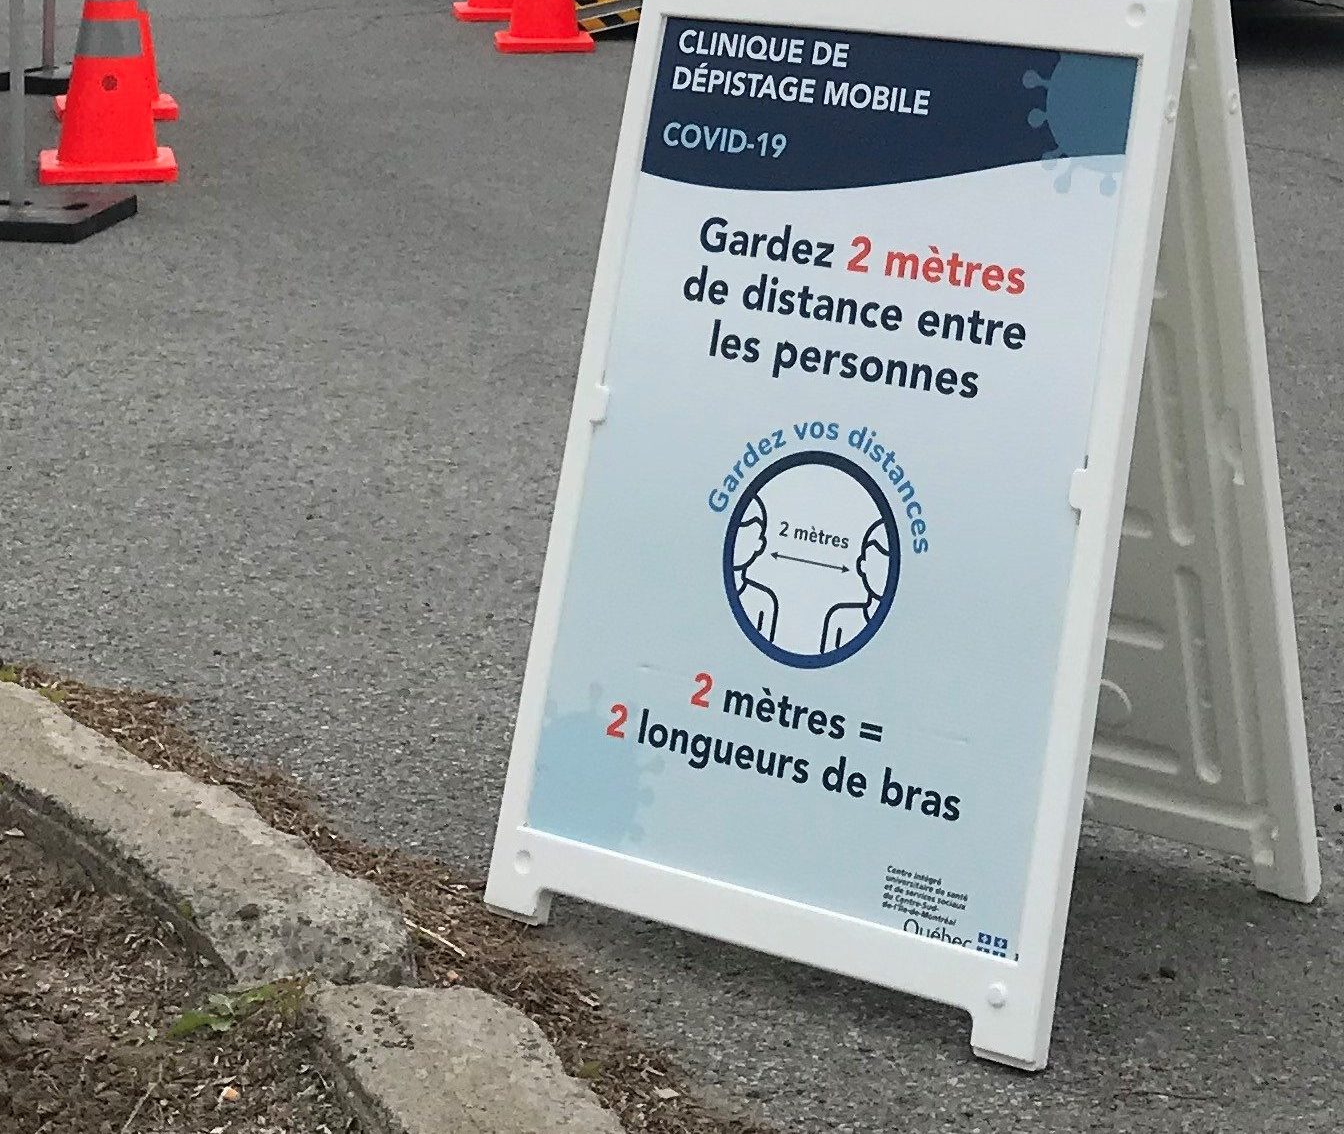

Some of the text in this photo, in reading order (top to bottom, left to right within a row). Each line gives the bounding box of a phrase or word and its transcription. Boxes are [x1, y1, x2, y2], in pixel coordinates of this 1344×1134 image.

[678, 28, 850, 68] CLINIQUE DE
[672, 63, 931, 116] DÉPISTAGE MOBILE
[662, 121, 788, 159] COVID-19
[699, 216, 1026, 295] Gardez 2 mètres
[683, 265, 1027, 351] de distance entre
[708, 320, 979, 400] les personnes
[708, 421, 929, 555] Gardez vos distances
[778, 520, 850, 549] 2 mètres
[690, 672, 884, 743] 2 mètres =
[606, 703, 961, 821] 2 longueurs de bras
[882, 892, 894, 900] du
[884, 883, 966, 911] et de services sociaux
[885, 875, 969, 902] universitaire de santé
[887, 865, 942, 886] Centre intégré
